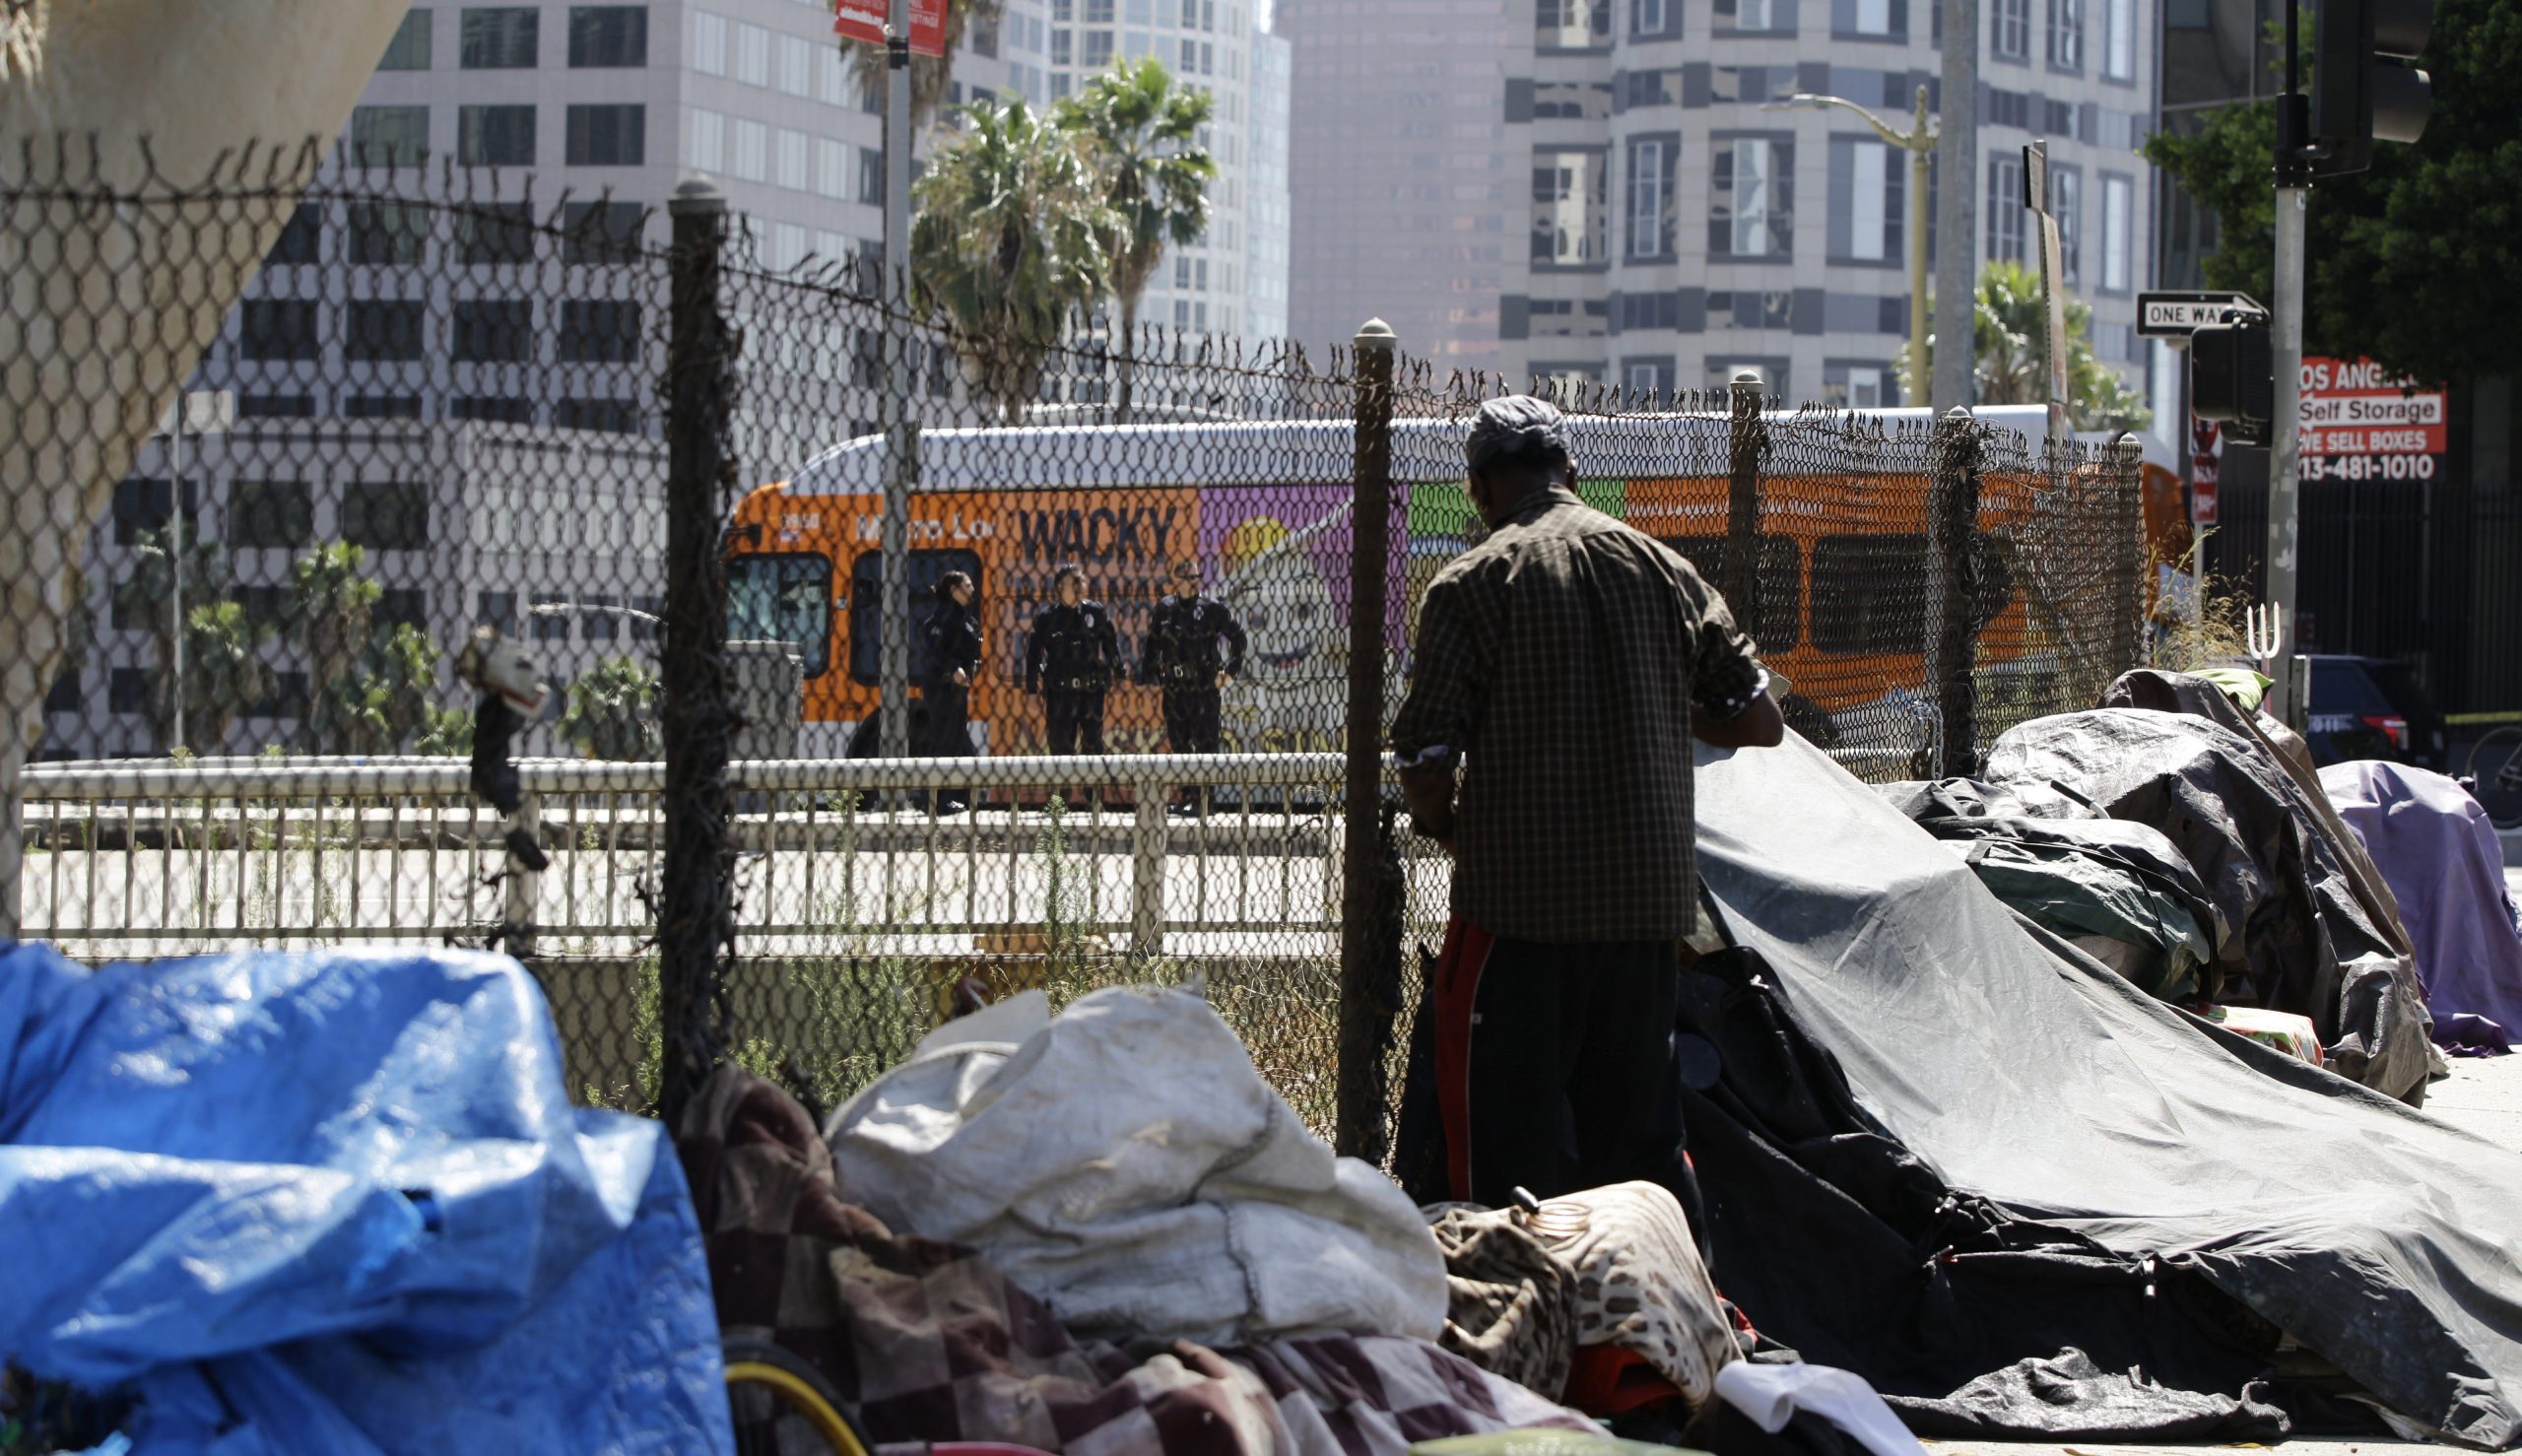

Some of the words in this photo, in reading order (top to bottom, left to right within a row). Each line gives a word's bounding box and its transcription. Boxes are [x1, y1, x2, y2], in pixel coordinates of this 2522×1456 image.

[2151, 306, 2185, 322] ONE
[2192, 306, 2223, 322] WA
[2298, 364, 2330, 391] OS
[2299, 400, 2340, 421] Self
[2349, 399, 2435, 424] Storage
[2327, 431, 2366, 451] SELL
[2369, 430, 2427, 450] BOXES
[2298, 454, 2434, 481] 13-481-1010
[1019, 506, 1176, 564] WACKY
